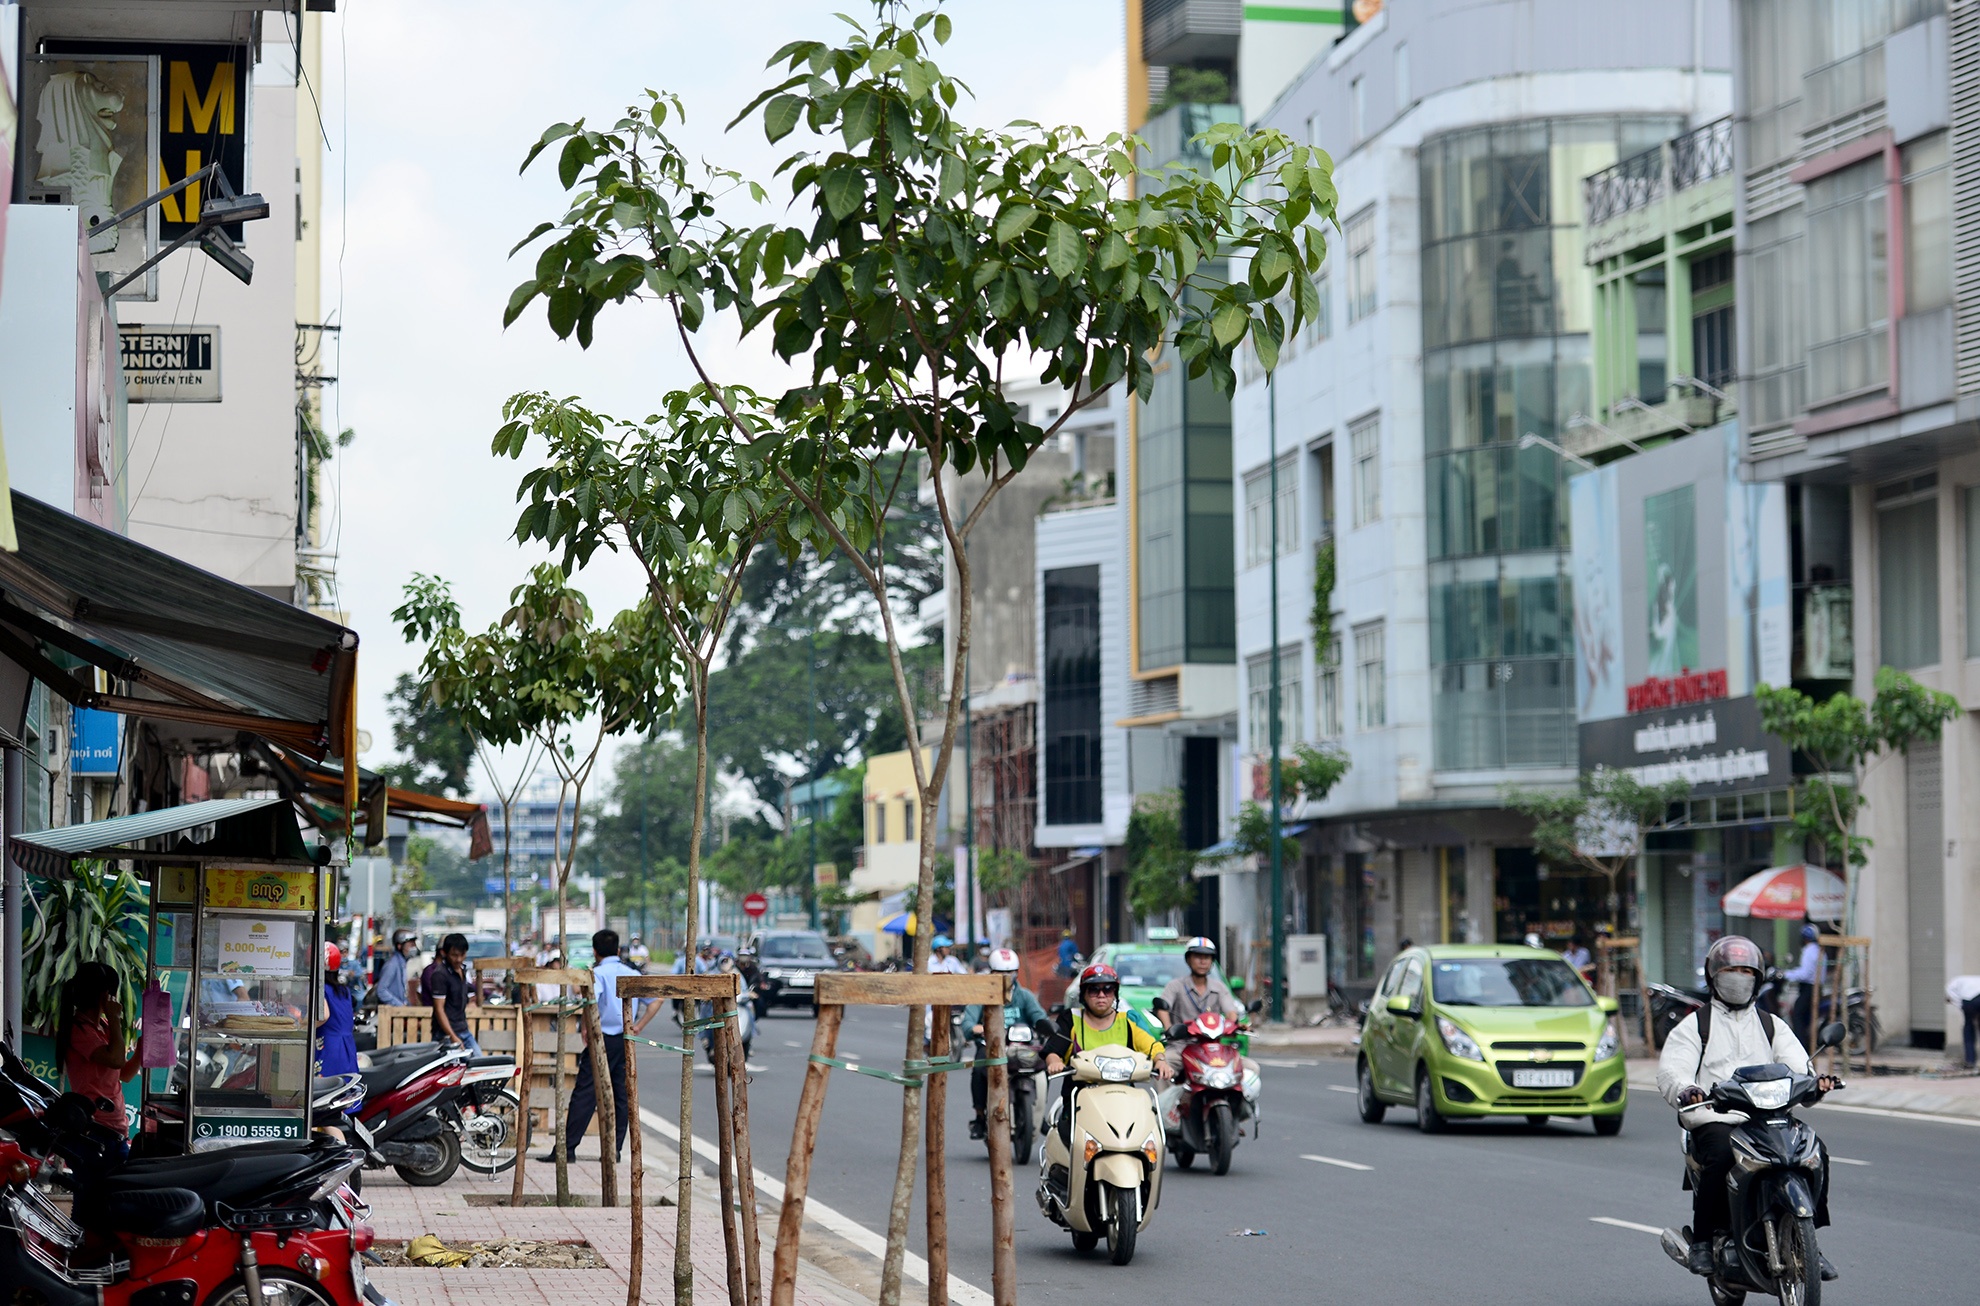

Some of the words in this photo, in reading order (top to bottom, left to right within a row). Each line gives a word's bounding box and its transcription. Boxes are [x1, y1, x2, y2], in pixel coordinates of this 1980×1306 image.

[224, 942, 255, 953] 8.000
[218, 1125, 248, 1137] 1900
[251, 1125, 281, 1137] 5555
[284, 1125, 299, 1138] 91
